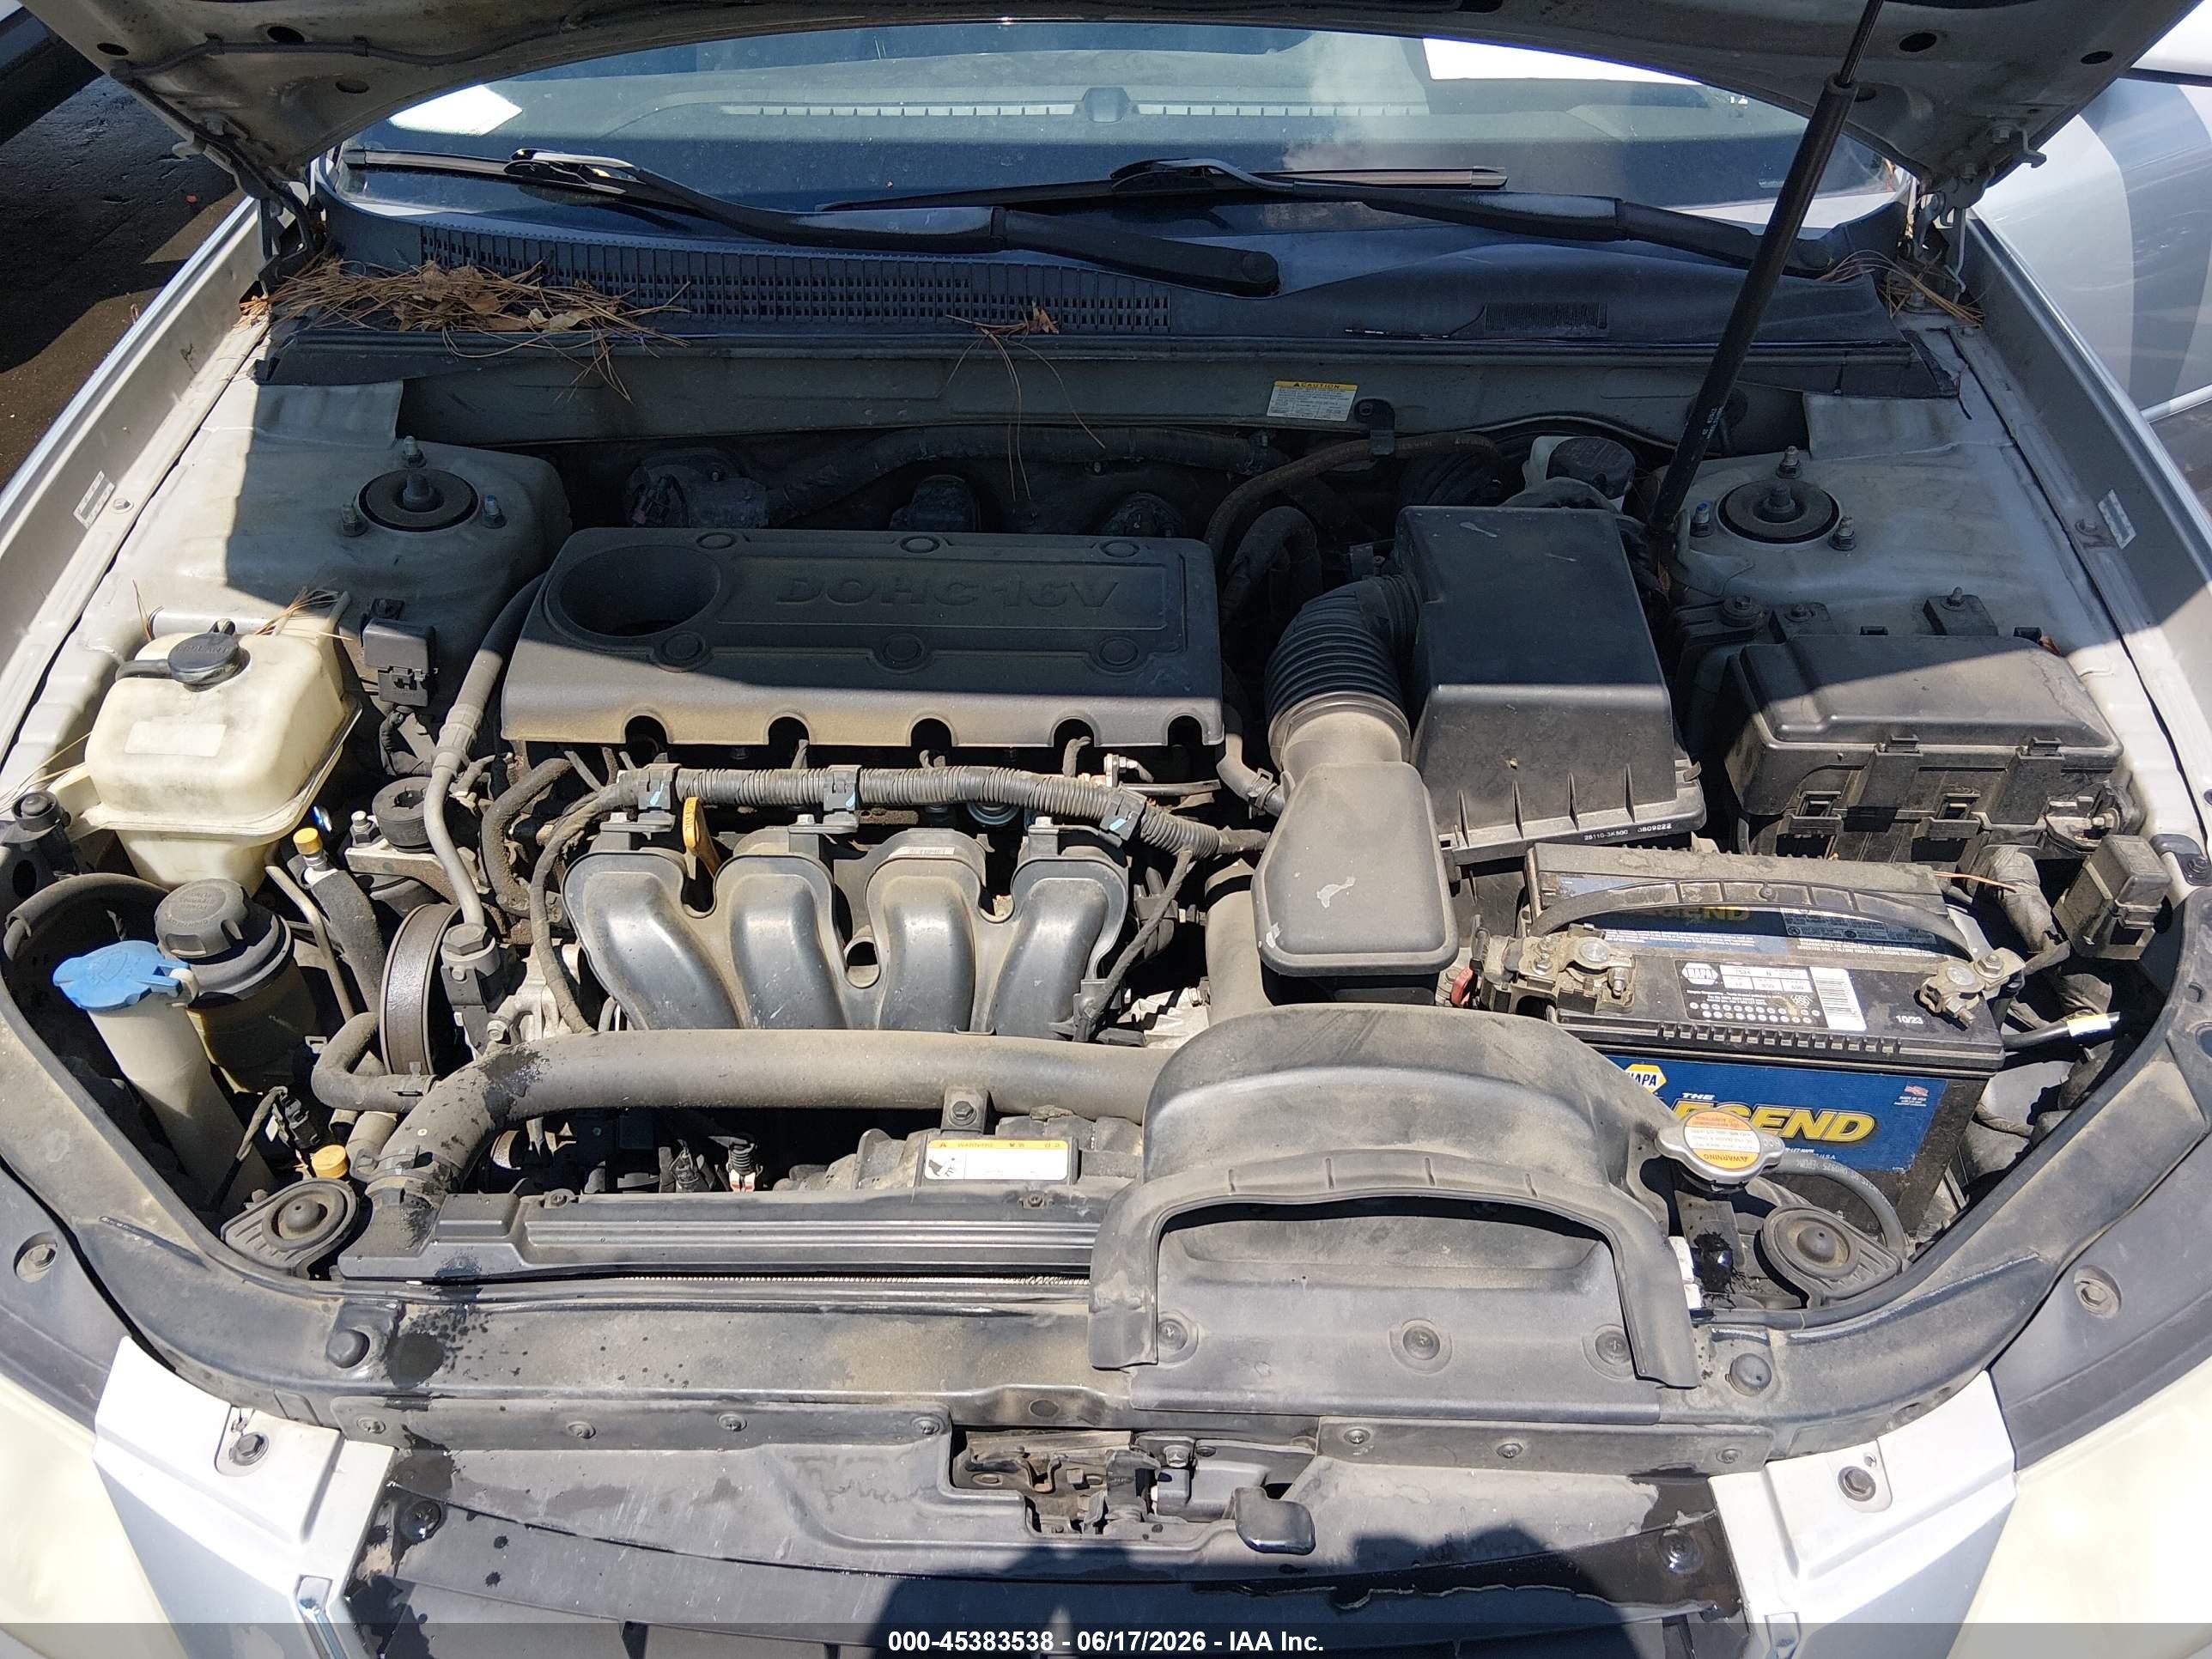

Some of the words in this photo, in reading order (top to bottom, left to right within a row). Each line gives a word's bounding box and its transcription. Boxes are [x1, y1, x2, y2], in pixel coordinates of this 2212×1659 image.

[774, 578, 981, 607] DOHC
[992, 576, 1119, 607] 16V
[1686, 967, 1716, 980] NAPA
[1895, 1014, 1924, 1025] 10/23
[1672, 1099, 1875, 1143] END
[1704, 1153, 1741, 1162] WARNING
